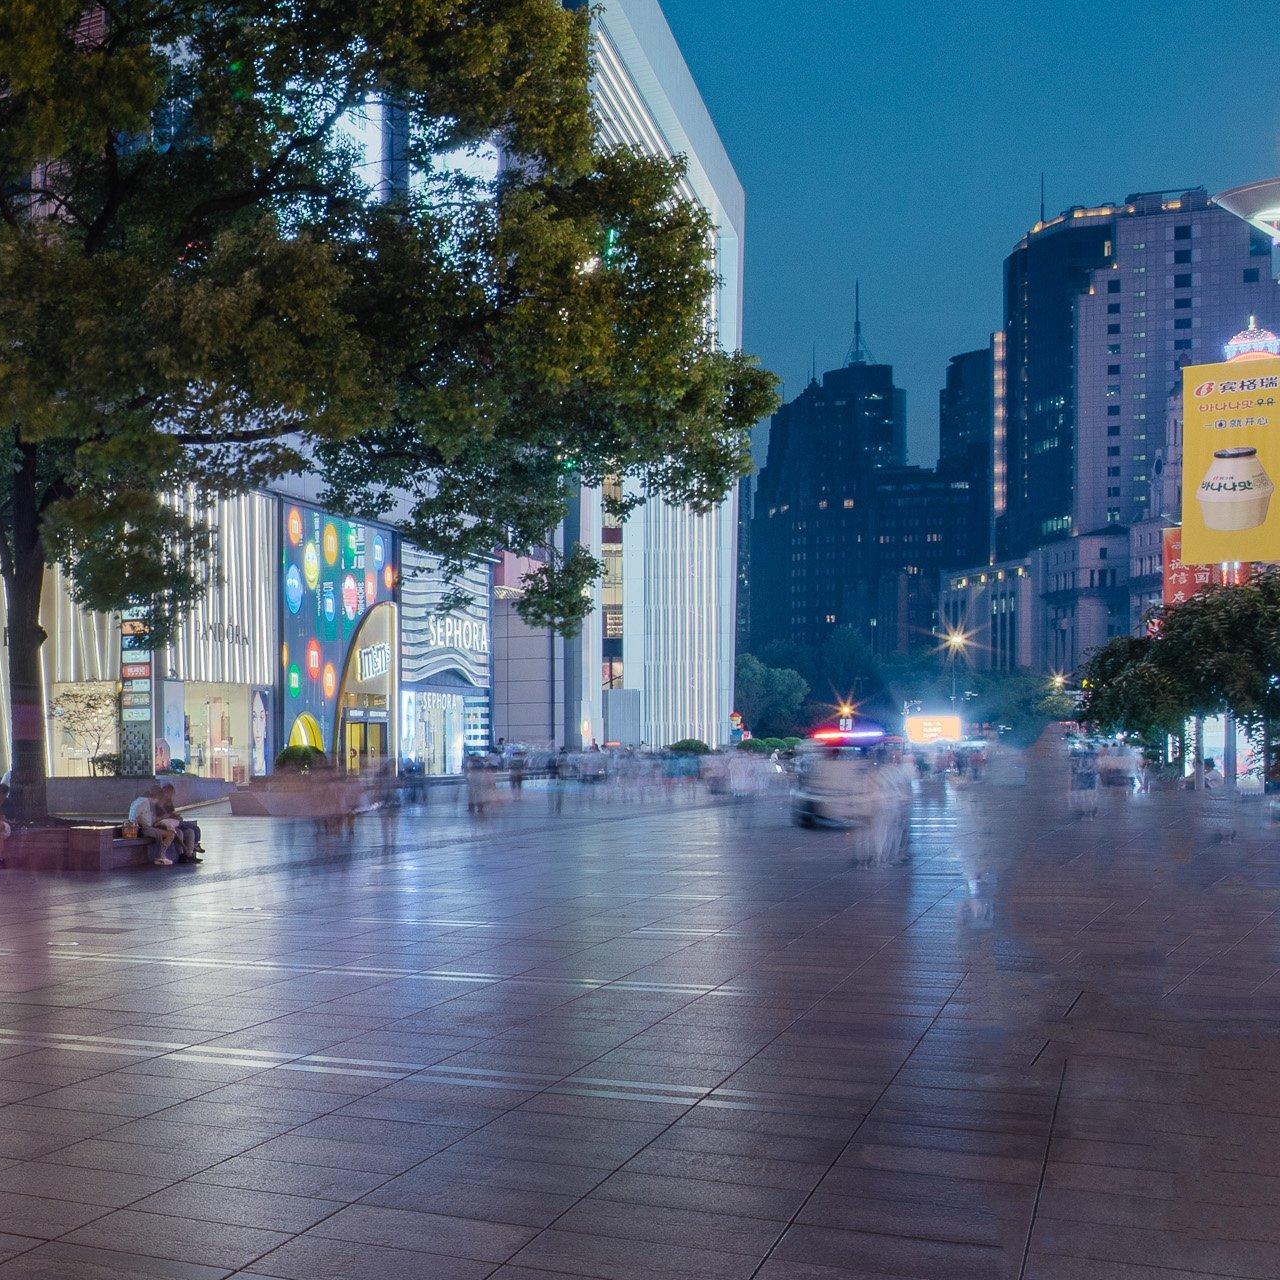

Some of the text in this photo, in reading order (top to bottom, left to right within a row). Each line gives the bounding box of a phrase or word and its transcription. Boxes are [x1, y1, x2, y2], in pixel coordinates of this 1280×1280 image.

[1219, 376, 1278, 394] 宾格瑞
[1199, 397, 1276, 412] 바나나맛 우유
[1201, 480, 1253, 493] 바나나맛
[196, 621, 250, 646] PANDORA
[427, 615, 488, 652] SEPHORA
[422, 692, 458, 711] SEPHORA
